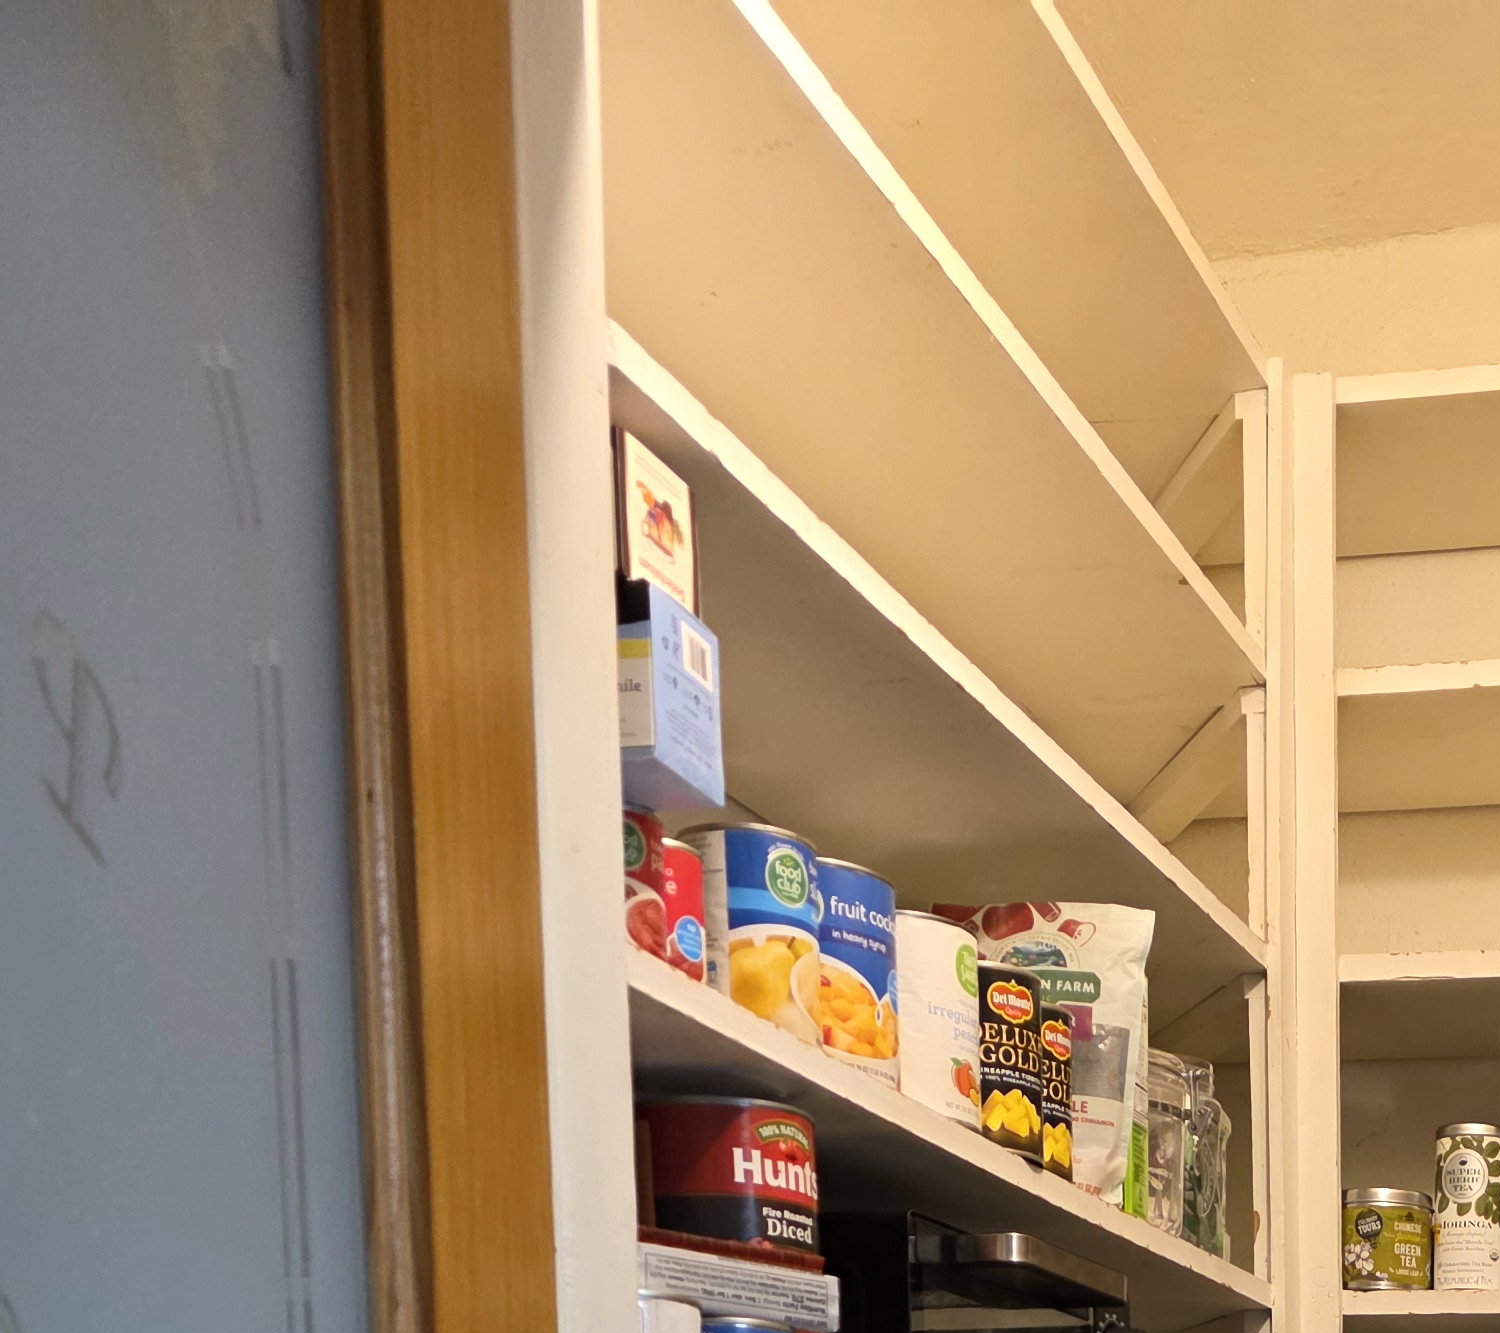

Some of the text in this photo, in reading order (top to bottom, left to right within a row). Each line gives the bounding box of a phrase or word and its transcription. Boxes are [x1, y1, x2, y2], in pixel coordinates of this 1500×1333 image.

[775, 860, 801, 881] food
[776, 877, 801, 894] club
[830, 896, 867, 923] fruit
[832, 930, 841, 938] in
[1056, 980, 1095, 993] FARM
[993, 991, 1032, 1010] Del Monte
[979, 1022, 1042, 1050] ELUX
[980, 1045, 1040, 1073] GOLD
[758, 1123, 779, 1137] 100%
[1446, 1168, 1481, 1177] SUPER
[1452, 1185, 1473, 1193] TEA
[763, 1206, 781, 1219] Fire
[767, 1218, 813, 1244] Diced
[1357, 1221, 1382, 1235] TOURS
[1394, 1221, 1422, 1234] CHINESE
[1394, 1243, 1421, 1257] GREEN
[1400, 1256, 1417, 1269] TEA
